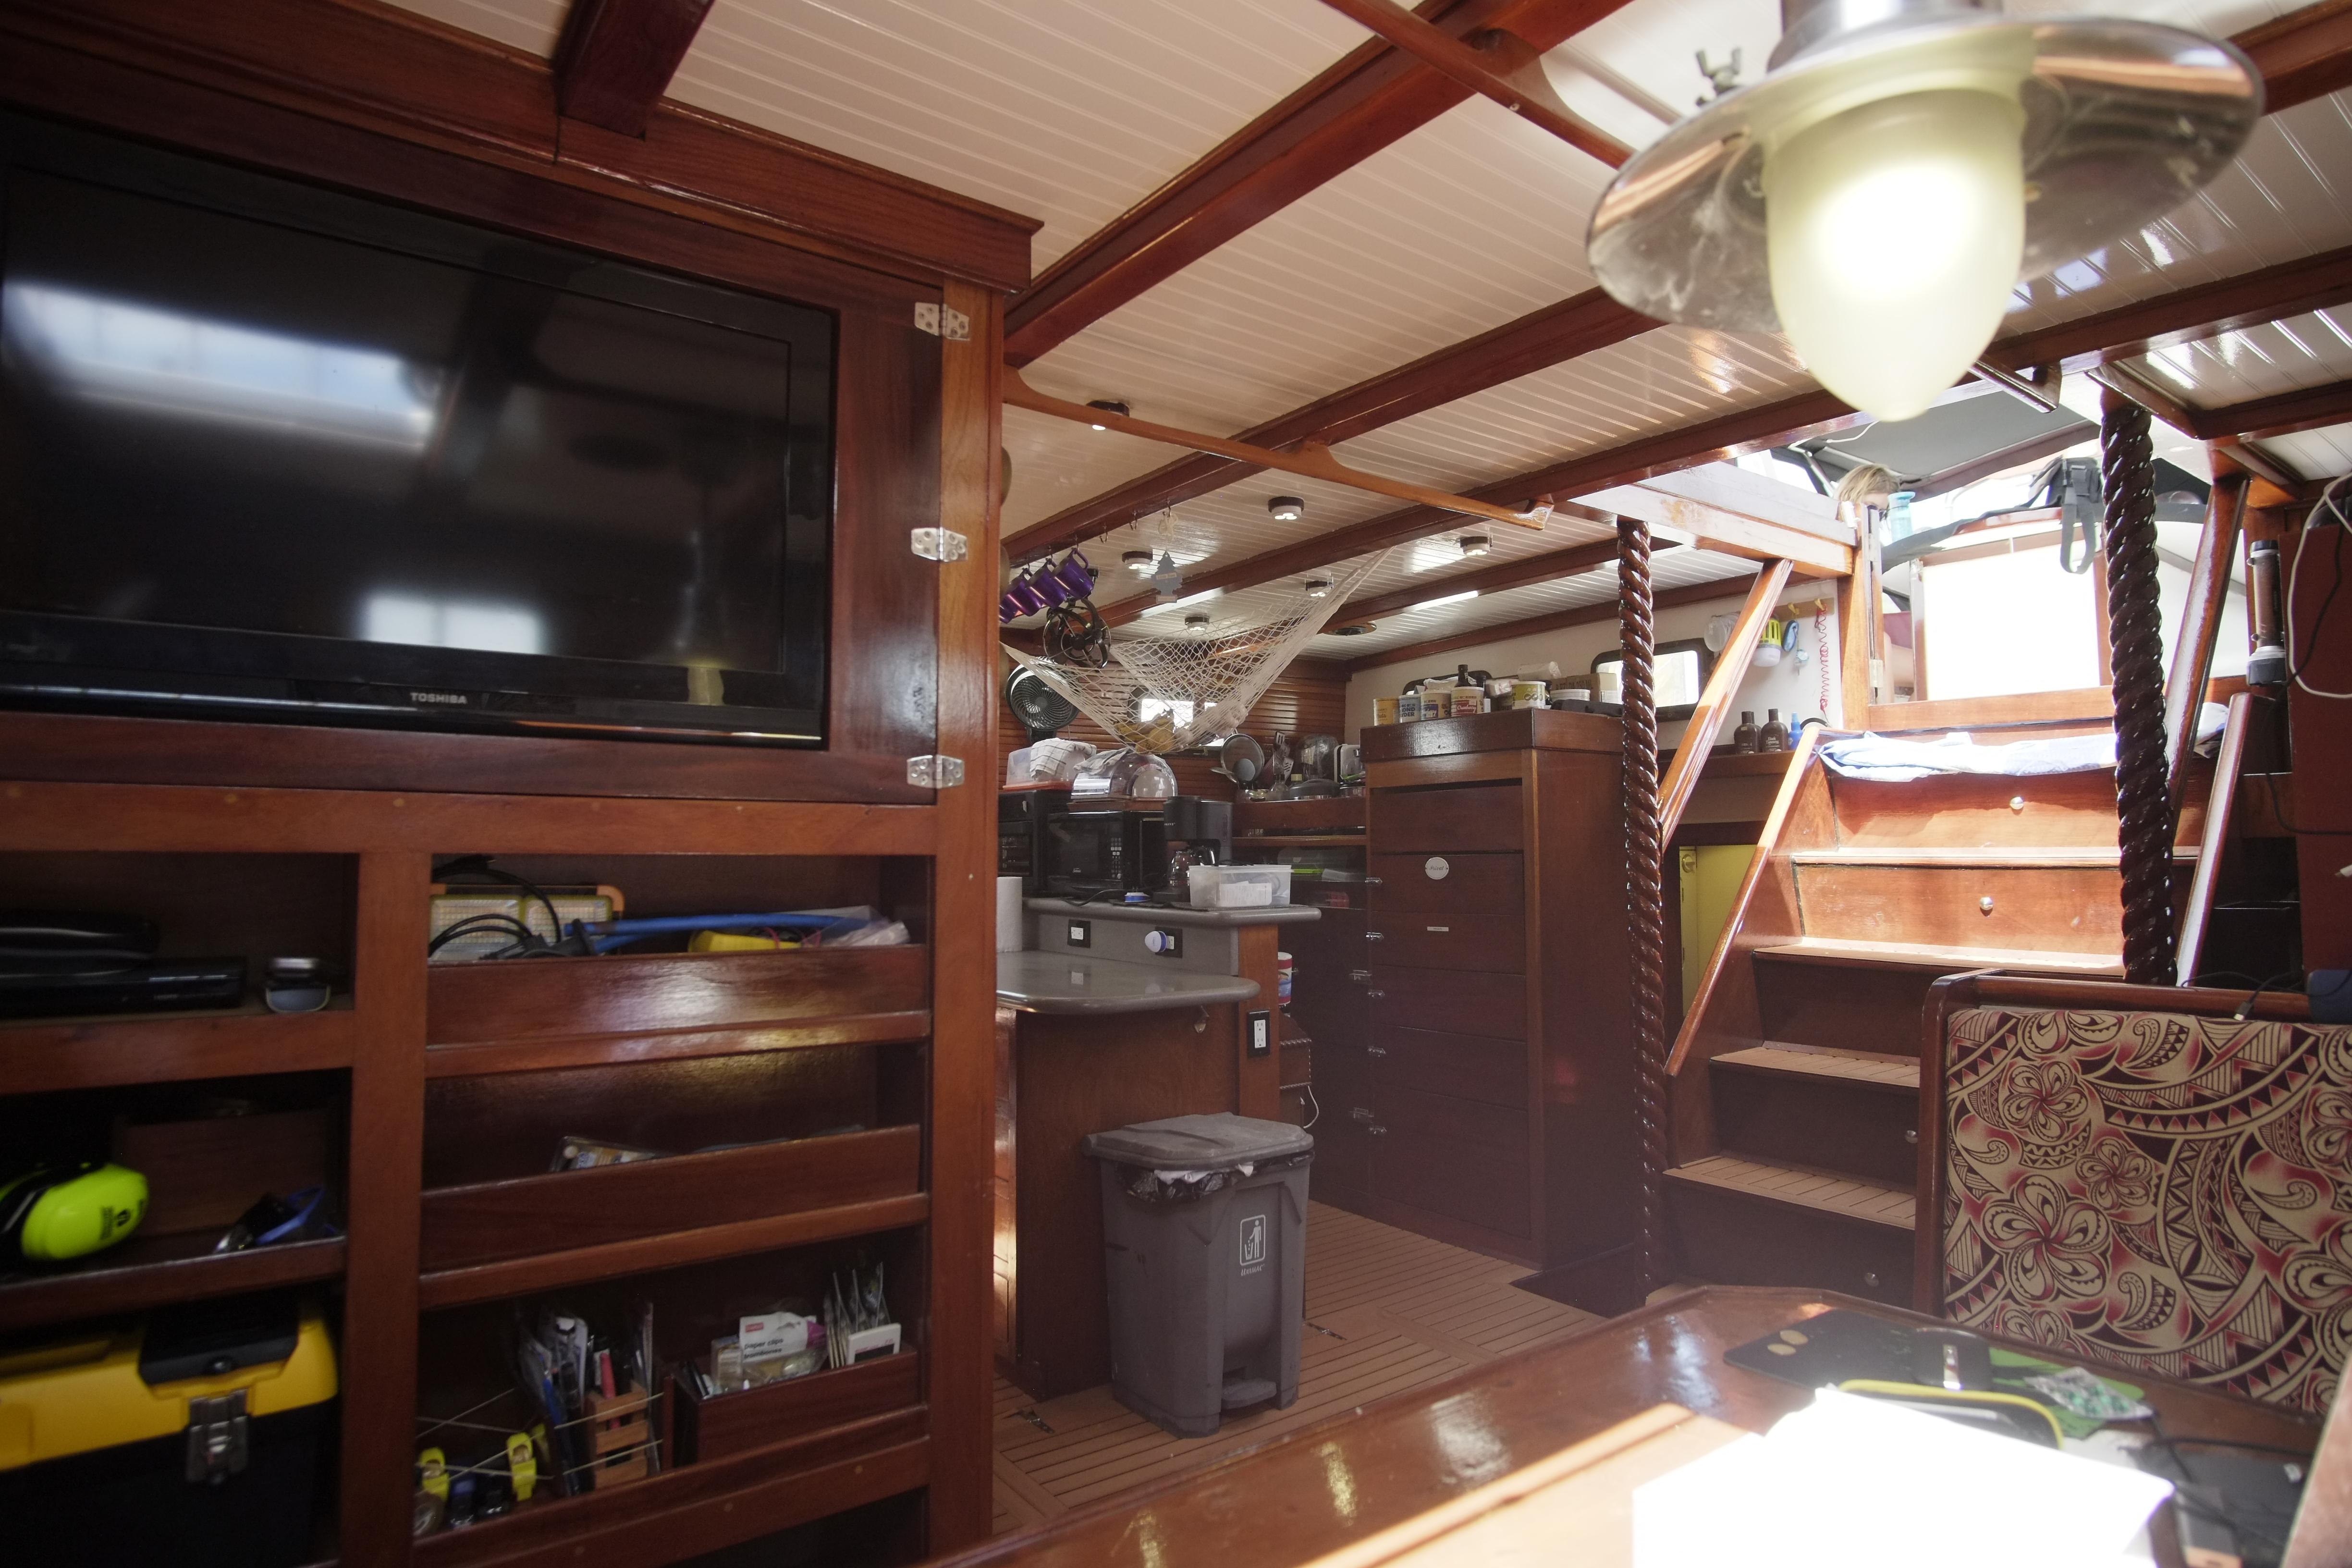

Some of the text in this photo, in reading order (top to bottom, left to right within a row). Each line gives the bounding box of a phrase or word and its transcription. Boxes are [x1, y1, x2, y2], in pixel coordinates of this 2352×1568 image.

[410, 693, 467, 704] TOSHIBA
[1457, 704, 1476, 713] Cranberry
[1241, 1264, 1263, 1276] UNIMAC
[745, 1338, 784, 1350] paper clips
[745, 1348, 783, 1359] trombones
